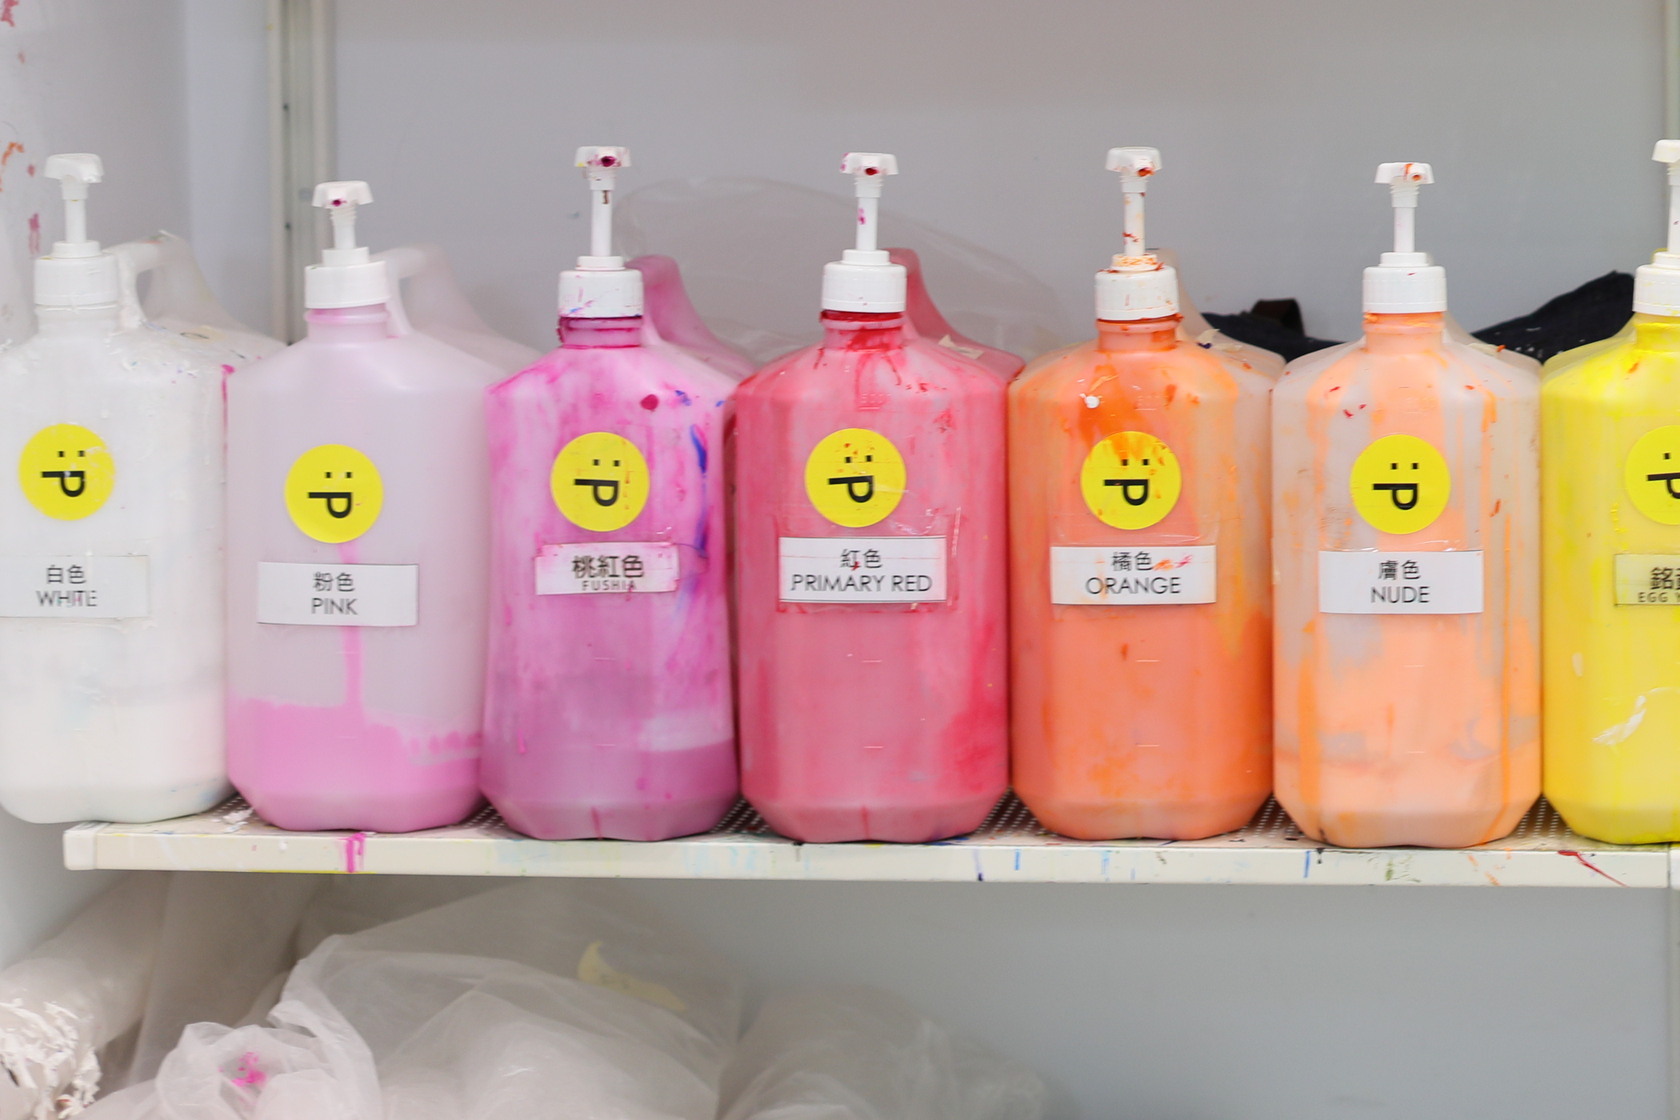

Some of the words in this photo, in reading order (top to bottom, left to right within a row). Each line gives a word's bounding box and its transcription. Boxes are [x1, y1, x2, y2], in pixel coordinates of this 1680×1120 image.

[571, 555, 644, 579] 桃紅色
[840, 548, 883, 569] 紅色
[1111, 551, 1153, 571] 橘色
[46, 564, 86, 584] 白色
[1378, 559, 1420, 580] 膚色
[312, 571, 355, 592] 粉色
[581, 580, 638, 591] FUSHIA
[789, 574, 886, 592] PRIMARY
[891, 575, 933, 592] RED
[1085, 577, 1181, 594] ORANGE
[35, 590, 97, 607] WHITE
[1371, 586, 1430, 603] NUDE
[1638, 592, 1668, 603] EGG
[311, 597, 358, 615] PINK
